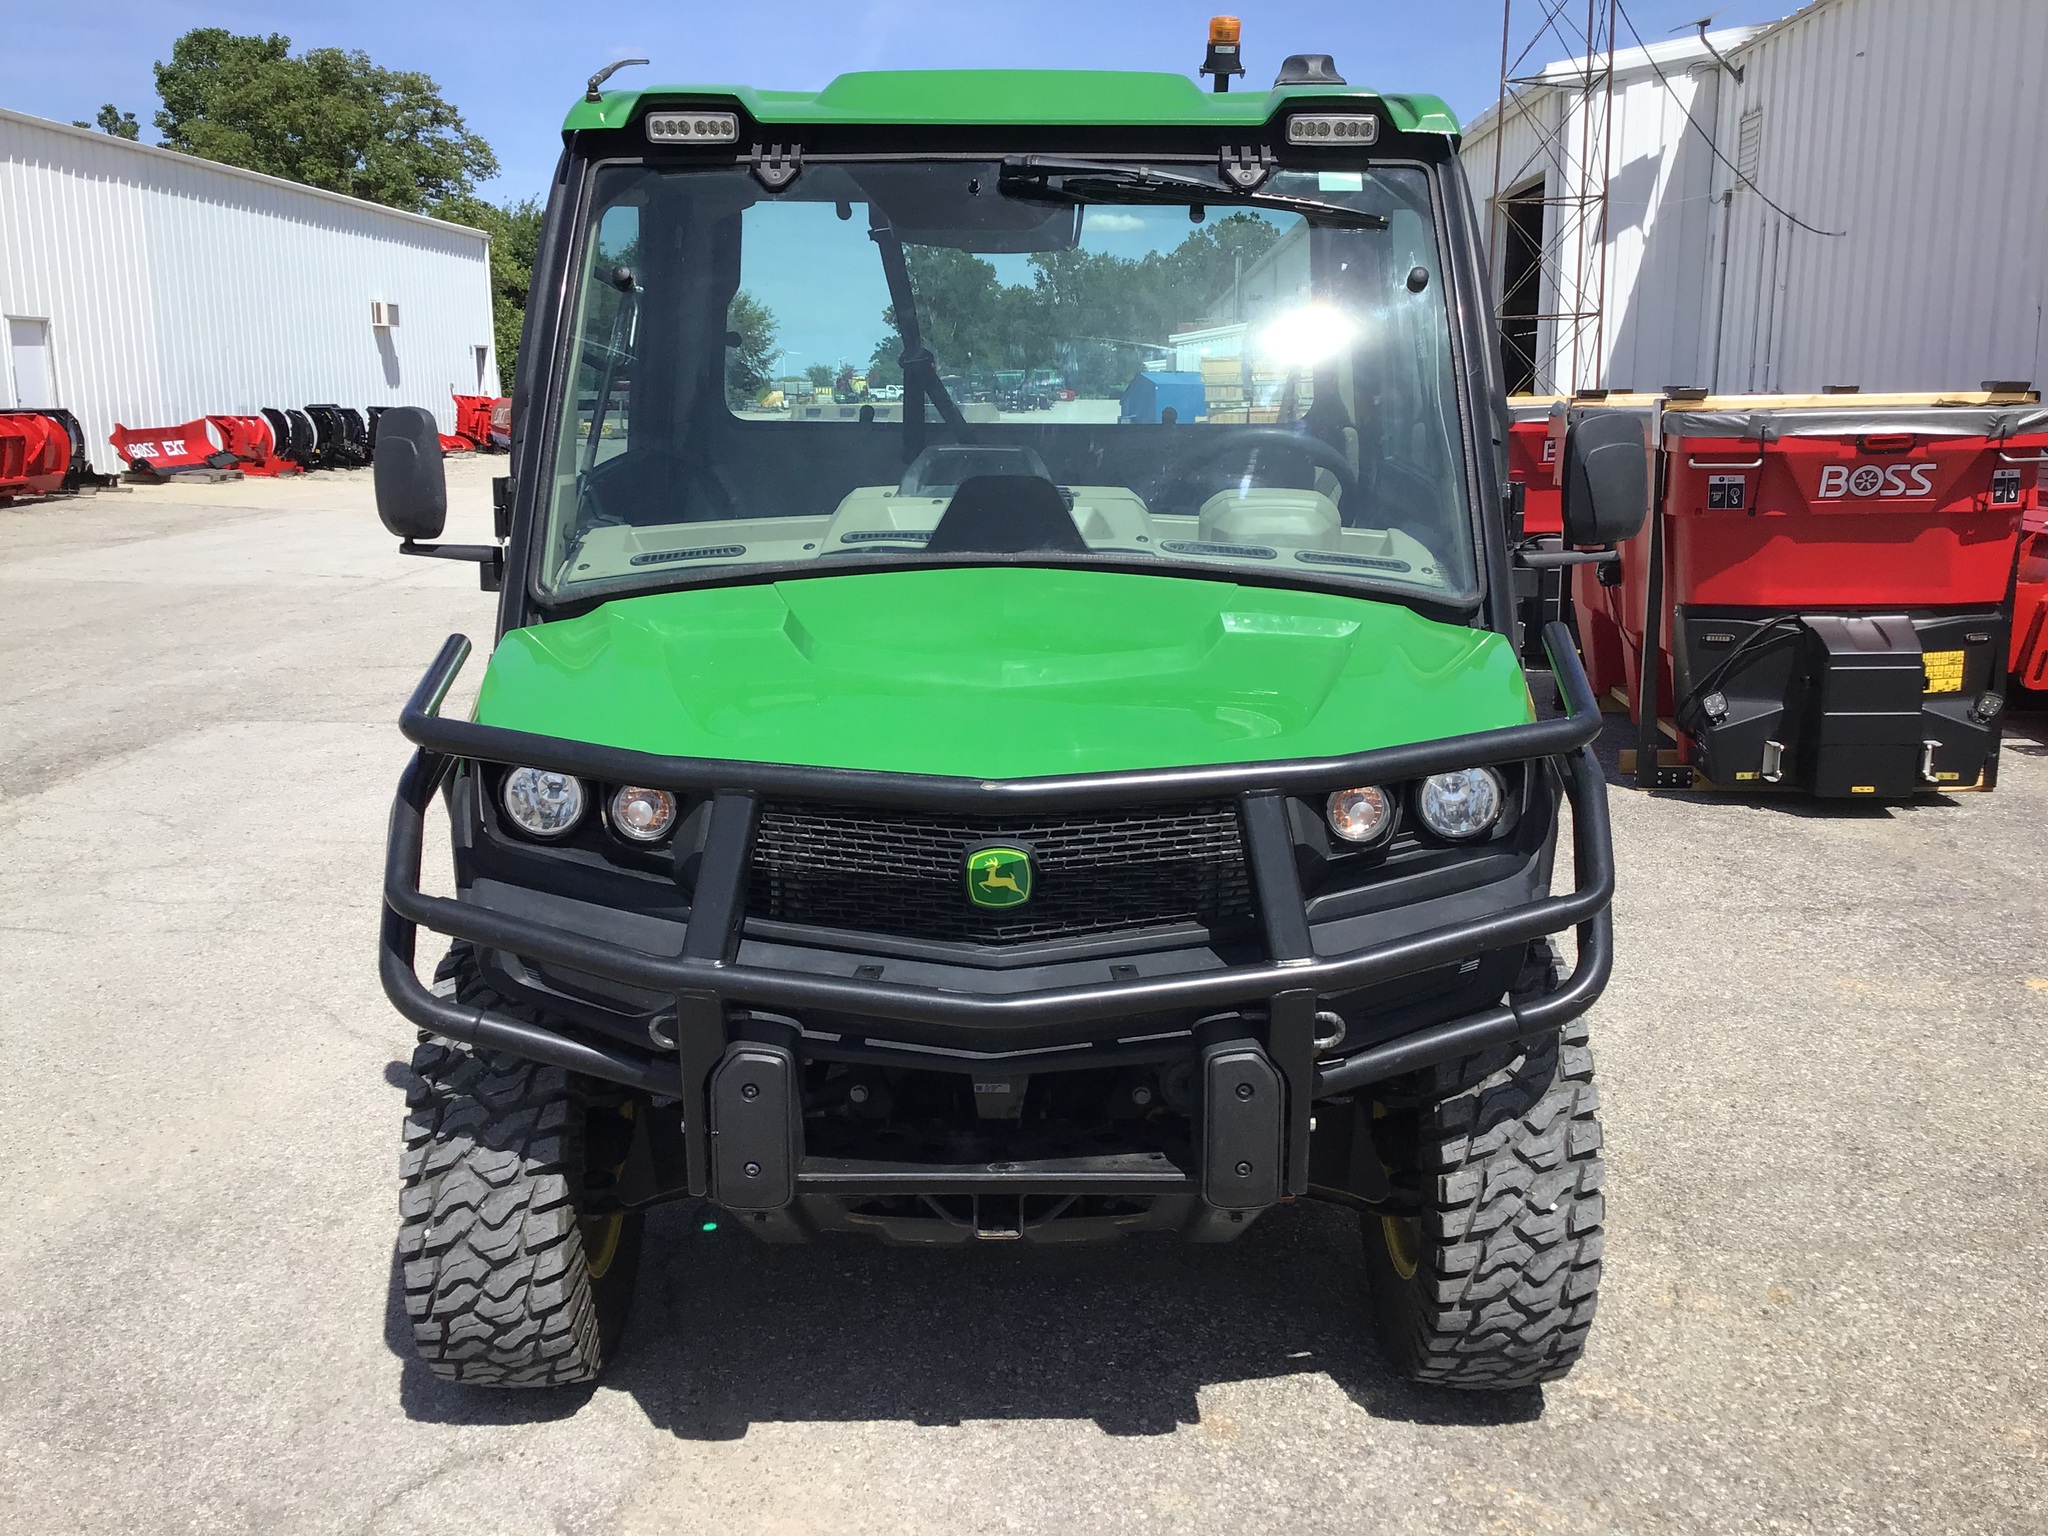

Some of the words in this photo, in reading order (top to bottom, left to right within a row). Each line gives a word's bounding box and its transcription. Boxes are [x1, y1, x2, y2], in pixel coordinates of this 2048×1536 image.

[128, 442, 159, 458] BOSS
[161, 440, 188, 456] EXT
[1818, 463, 1937, 498] BOSS
